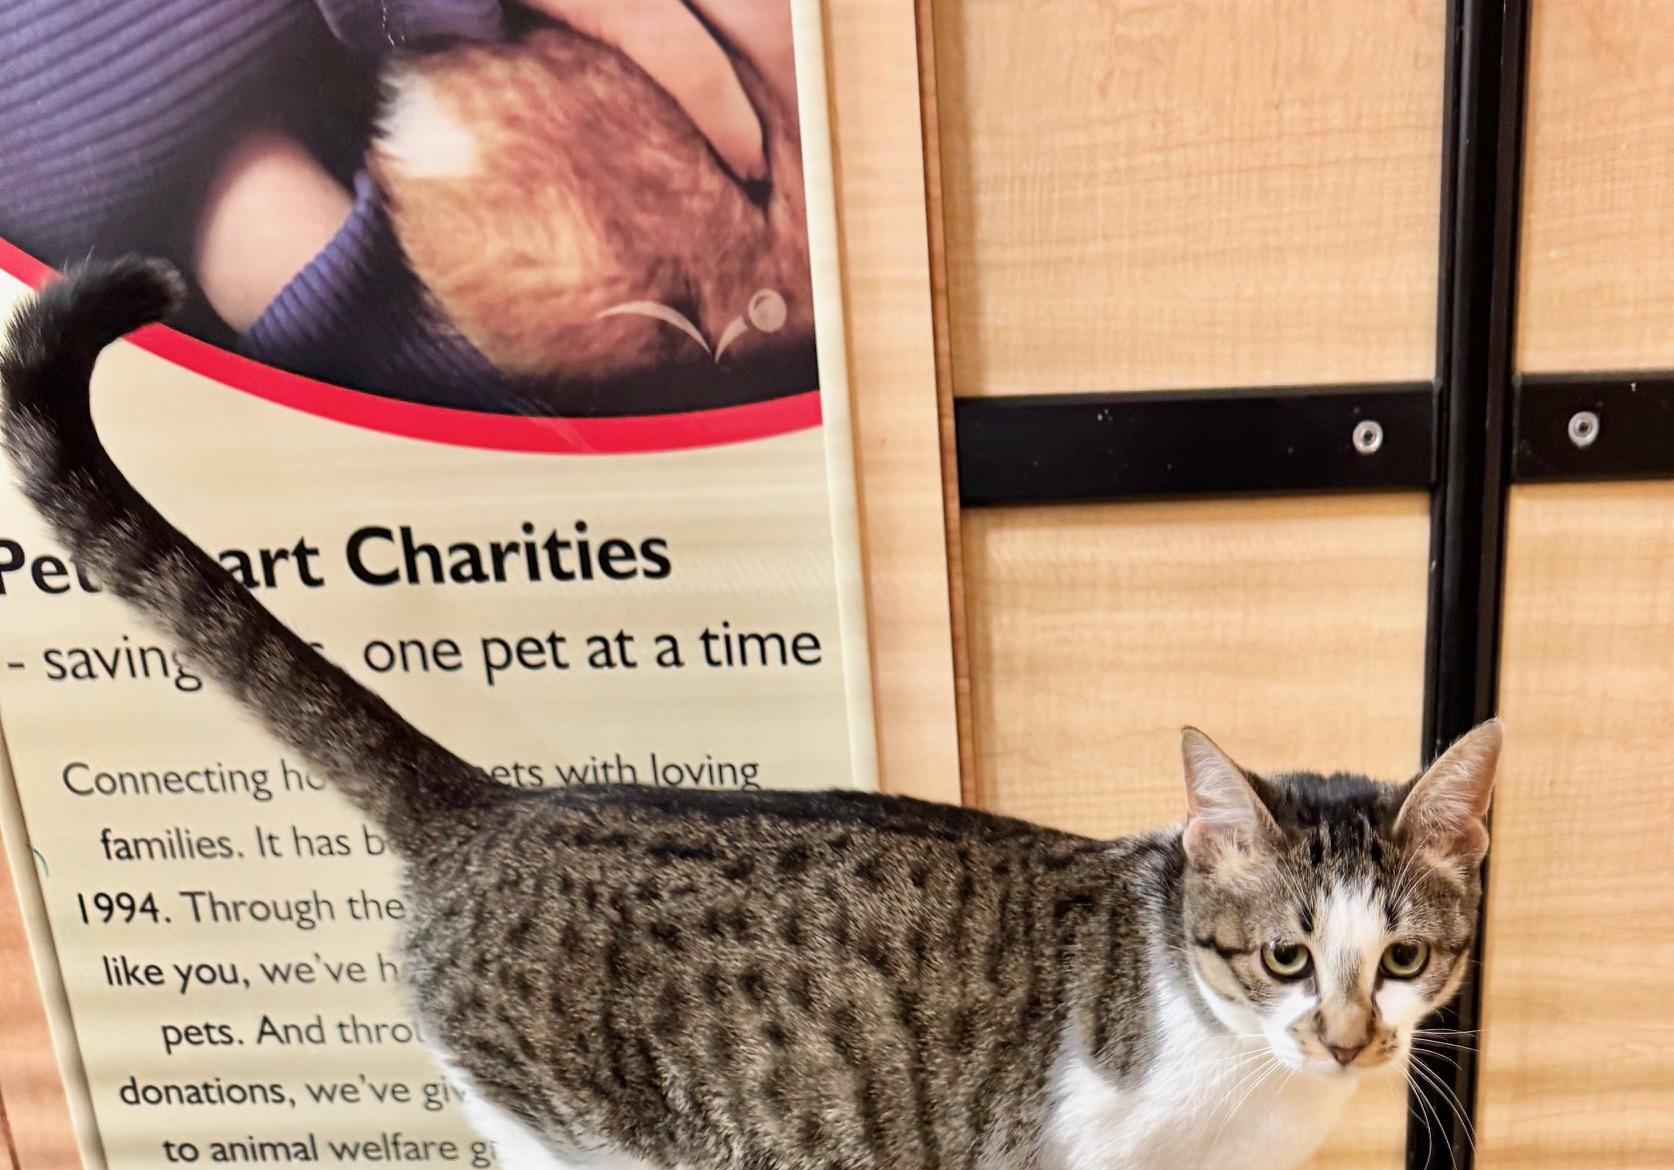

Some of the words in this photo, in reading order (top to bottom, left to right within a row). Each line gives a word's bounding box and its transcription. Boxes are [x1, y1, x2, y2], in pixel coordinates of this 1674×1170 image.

[0, 535, 325, 595] Petart
[346, 520, 672, 594] Charities
[43, 634, 203, 692] saving
[363, 638, 463, 673] one
[481, 630, 570, 687] pet
[586, 629, 638, 669] at
[653, 634, 685, 668] a
[698, 620, 822, 668] time
[62, 762, 273, 802] Connecting
[491, 762, 545, 788] ets
[555, 753, 638, 785] with
[651, 752, 761, 790] loving
[100, 827, 244, 861] families.
[255, 826, 282, 858] It
[292, 825, 352, 858] has
[77, 891, 172, 924] 1994.
[178, 889, 336, 931] Through
[347, 889, 405, 921] the
[102, 954, 165, 987] like
[173, 963, 251, 995] you,
[260, 952, 367, 984] we've
[161, 1018, 244, 1055] pets.
[256, 1014, 326, 1045] And
[338, 1014, 425, 1044] thro
[119, 1075, 296, 1109] donations,
[304, 1073, 411, 1104] we've
[162, 1137, 200, 1163] to
[209, 1132, 319, 1163] animal
[327, 1132, 459, 1161] welfare
